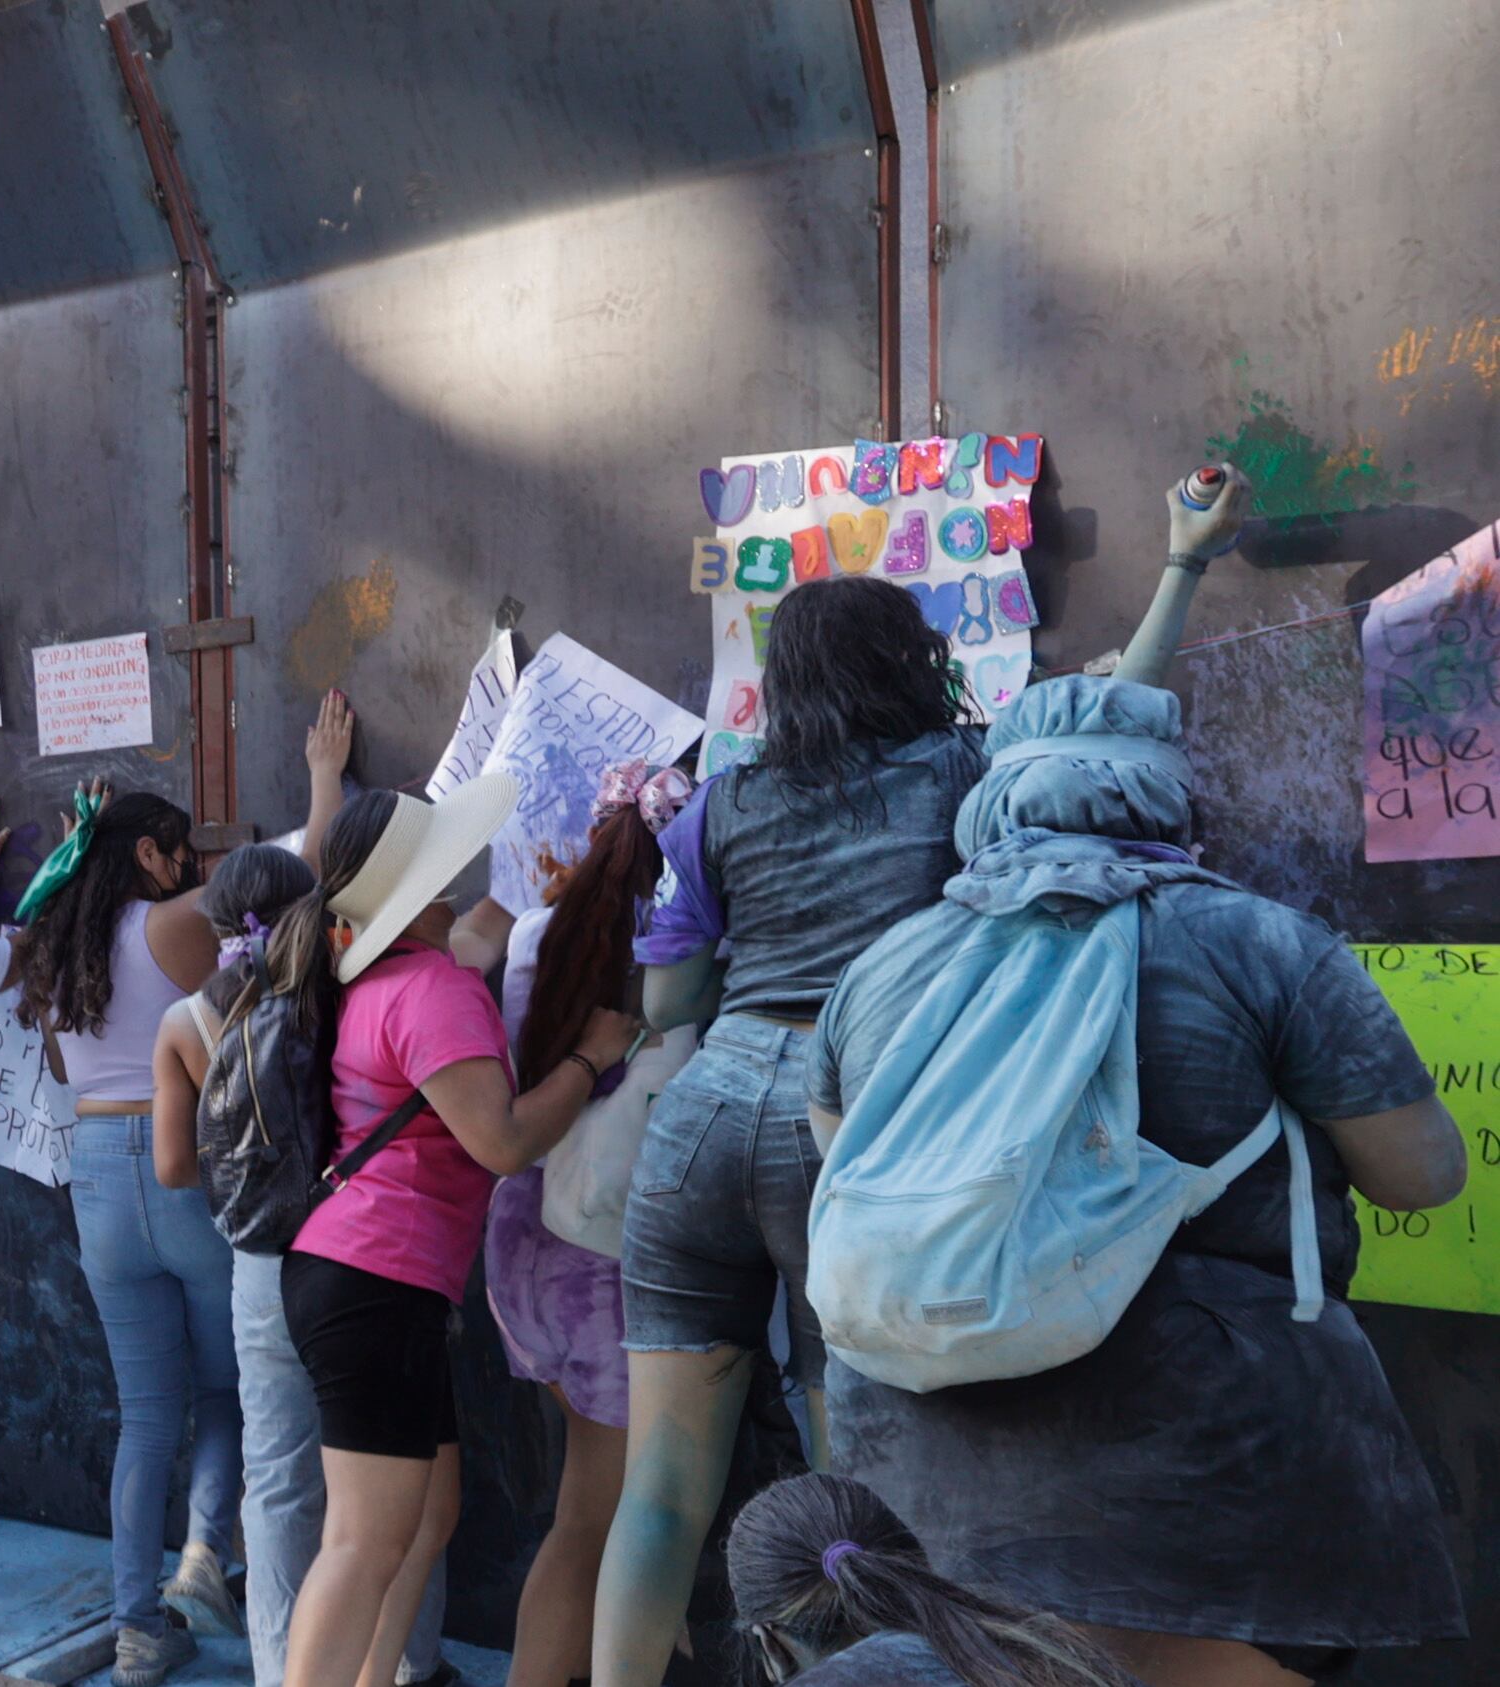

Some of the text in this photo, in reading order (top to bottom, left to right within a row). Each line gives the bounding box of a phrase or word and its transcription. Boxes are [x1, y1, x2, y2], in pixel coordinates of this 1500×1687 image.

[937, 497, 1034, 564] NO
[39, 651, 71, 667] CIRO
[75, 642, 126, 661] MEDINA
[524, 652, 564, 689] EL
[554, 678, 675, 764] ESTADO
[528, 700, 577, 748] POR
[1379, 727, 1494, 781] que
[1376, 767, 1496, 820] a la
